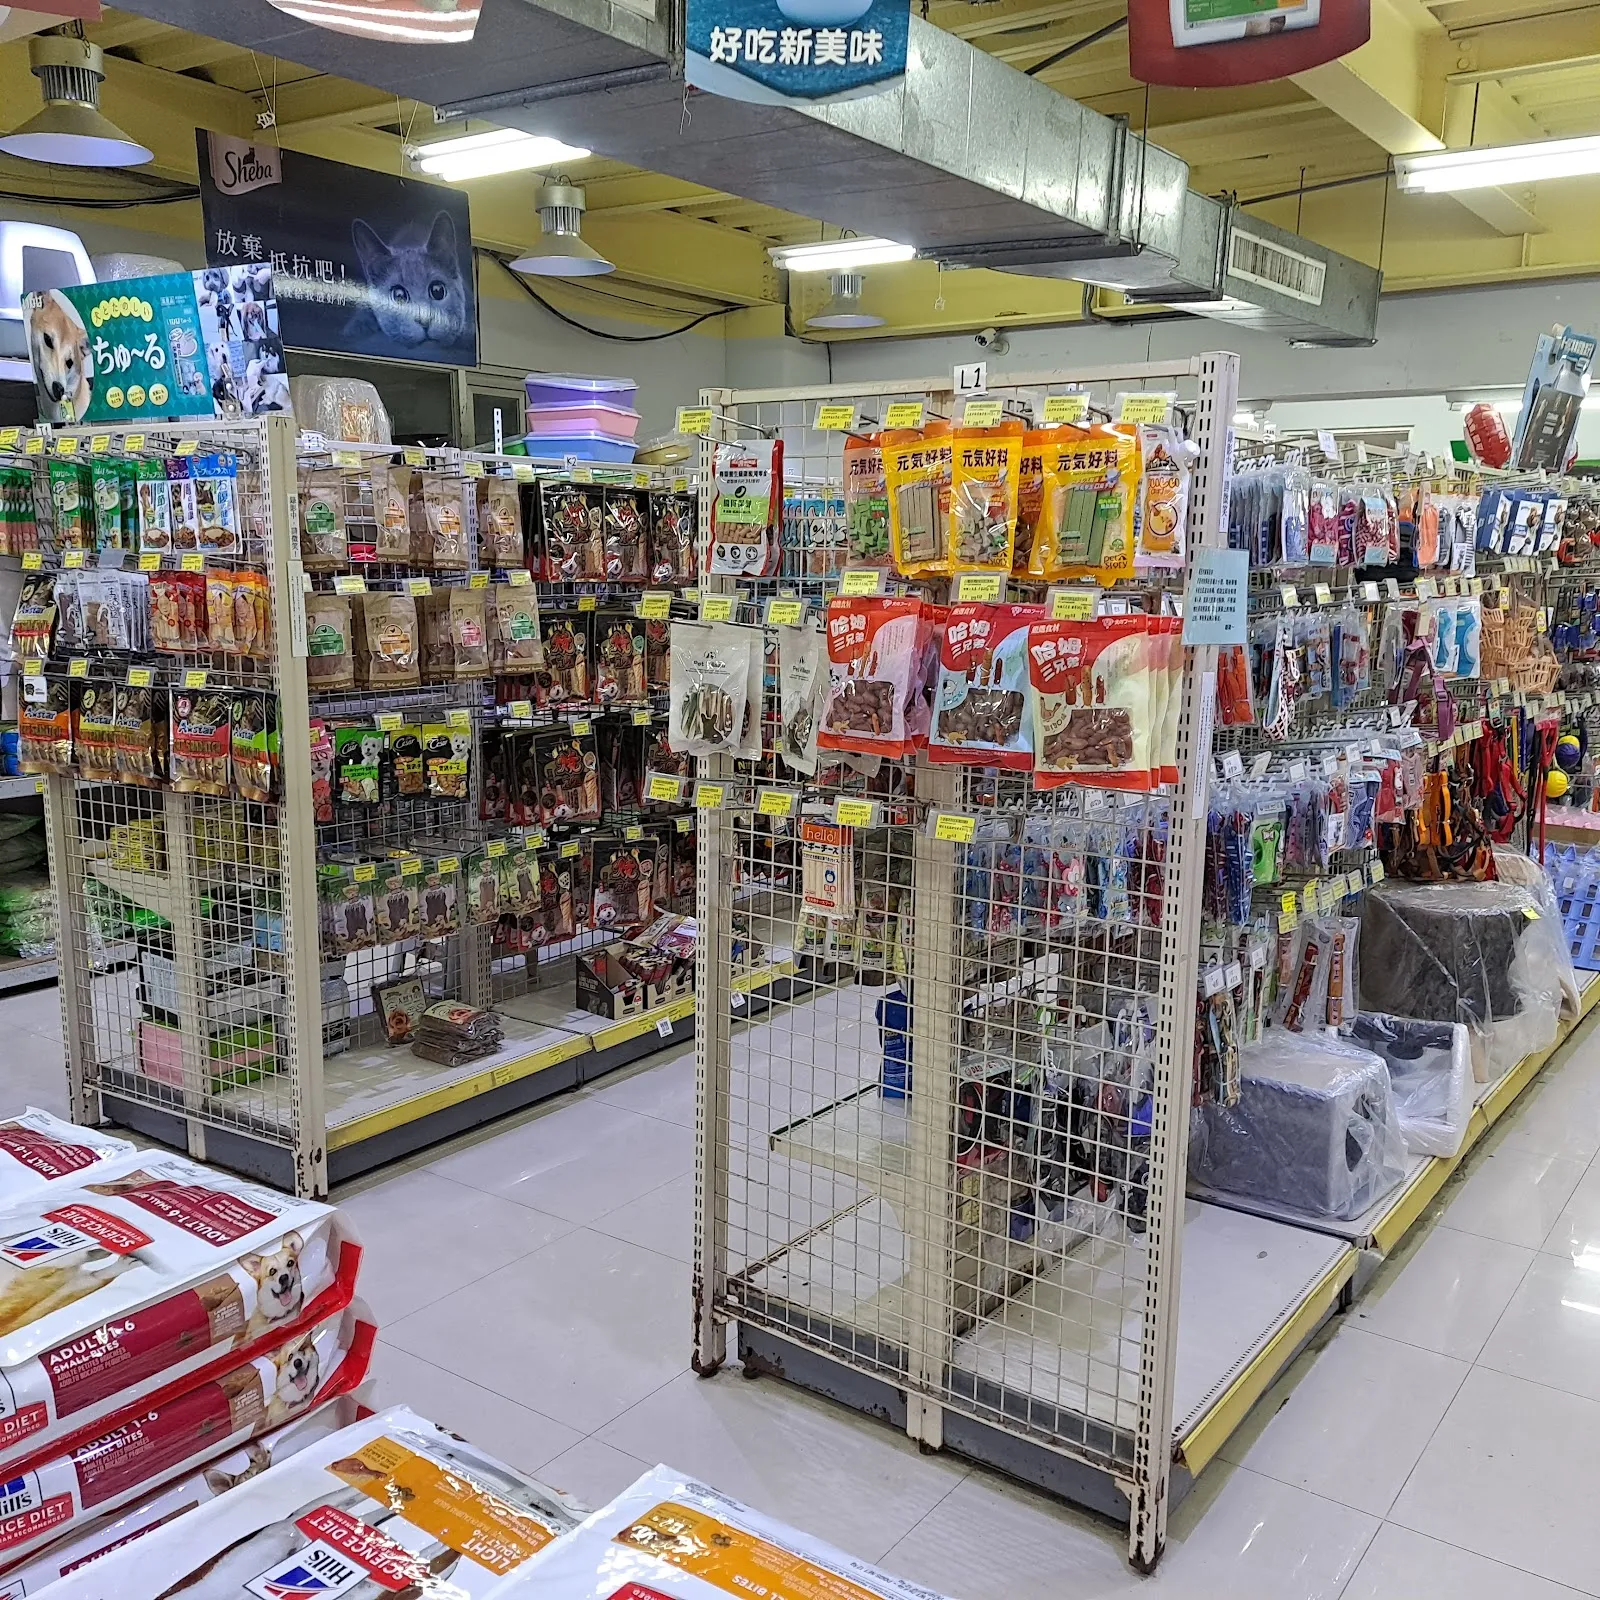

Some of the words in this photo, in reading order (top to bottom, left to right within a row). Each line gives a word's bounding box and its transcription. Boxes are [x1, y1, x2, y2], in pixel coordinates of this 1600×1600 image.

[710, 26, 882, 65] 好吃新美味
[222, 151, 273, 187] Sheba
[215, 229, 263, 260] 放棄
[960, 368, 982, 389] L1
[566, 456, 577, 466] K2
[896, 446, 952, 473] 元気好料
[962, 448, 1008, 468] 元気好料
[1020, 456, 1043, 475] 好料
[1057, 449, 1119, 472] 元気好料
[829, 613, 867, 638] 哈姆
[948, 618, 991, 645] 哈姆
[833, 632, 865, 653] 三兄弟
[951, 638, 986, 660] 三兄弟
[1030, 637, 1083, 666] 哈姆
[1040, 656, 1080, 682] 三兄弟
[806, 826, 837, 844] hello!
[27, 1156, 62, 1175] ADULT
[54, 1209, 86, 1225] DIET
[166, 1209, 190, 1224] 1-6
[81, 1221, 136, 1248] SCIENCE
[184, 1220, 232, 1242] ADULT
[50, 1333, 104, 1366] ADULT
[53, 1353, 89, 1375] SMALL
[90, 1340, 120, 1358] BITES
[0, 1422, 41, 1444] OMMENDED
[4, 1410, 39, 1433] DIET
[76, 1425, 128, 1458] ADULT
[131, 1411, 159, 1429] 1-6
[81, 1446, 115, 1466] SMALL
[115, 1429, 144, 1449] BITES
[30, 1500, 65, 1521] DIET
[14, 1513, 66, 1538] RECOMMENDED
[308, 1515, 348, 1541] DIET
[342, 1535, 405, 1580] SCIENCE
[460, 1537, 511, 1570] LIGHT
[485, 1537, 521, 1560] ADULT
[308, 1550, 355, 1586] Hill's
[731, 1573, 768, 1596] BITES
